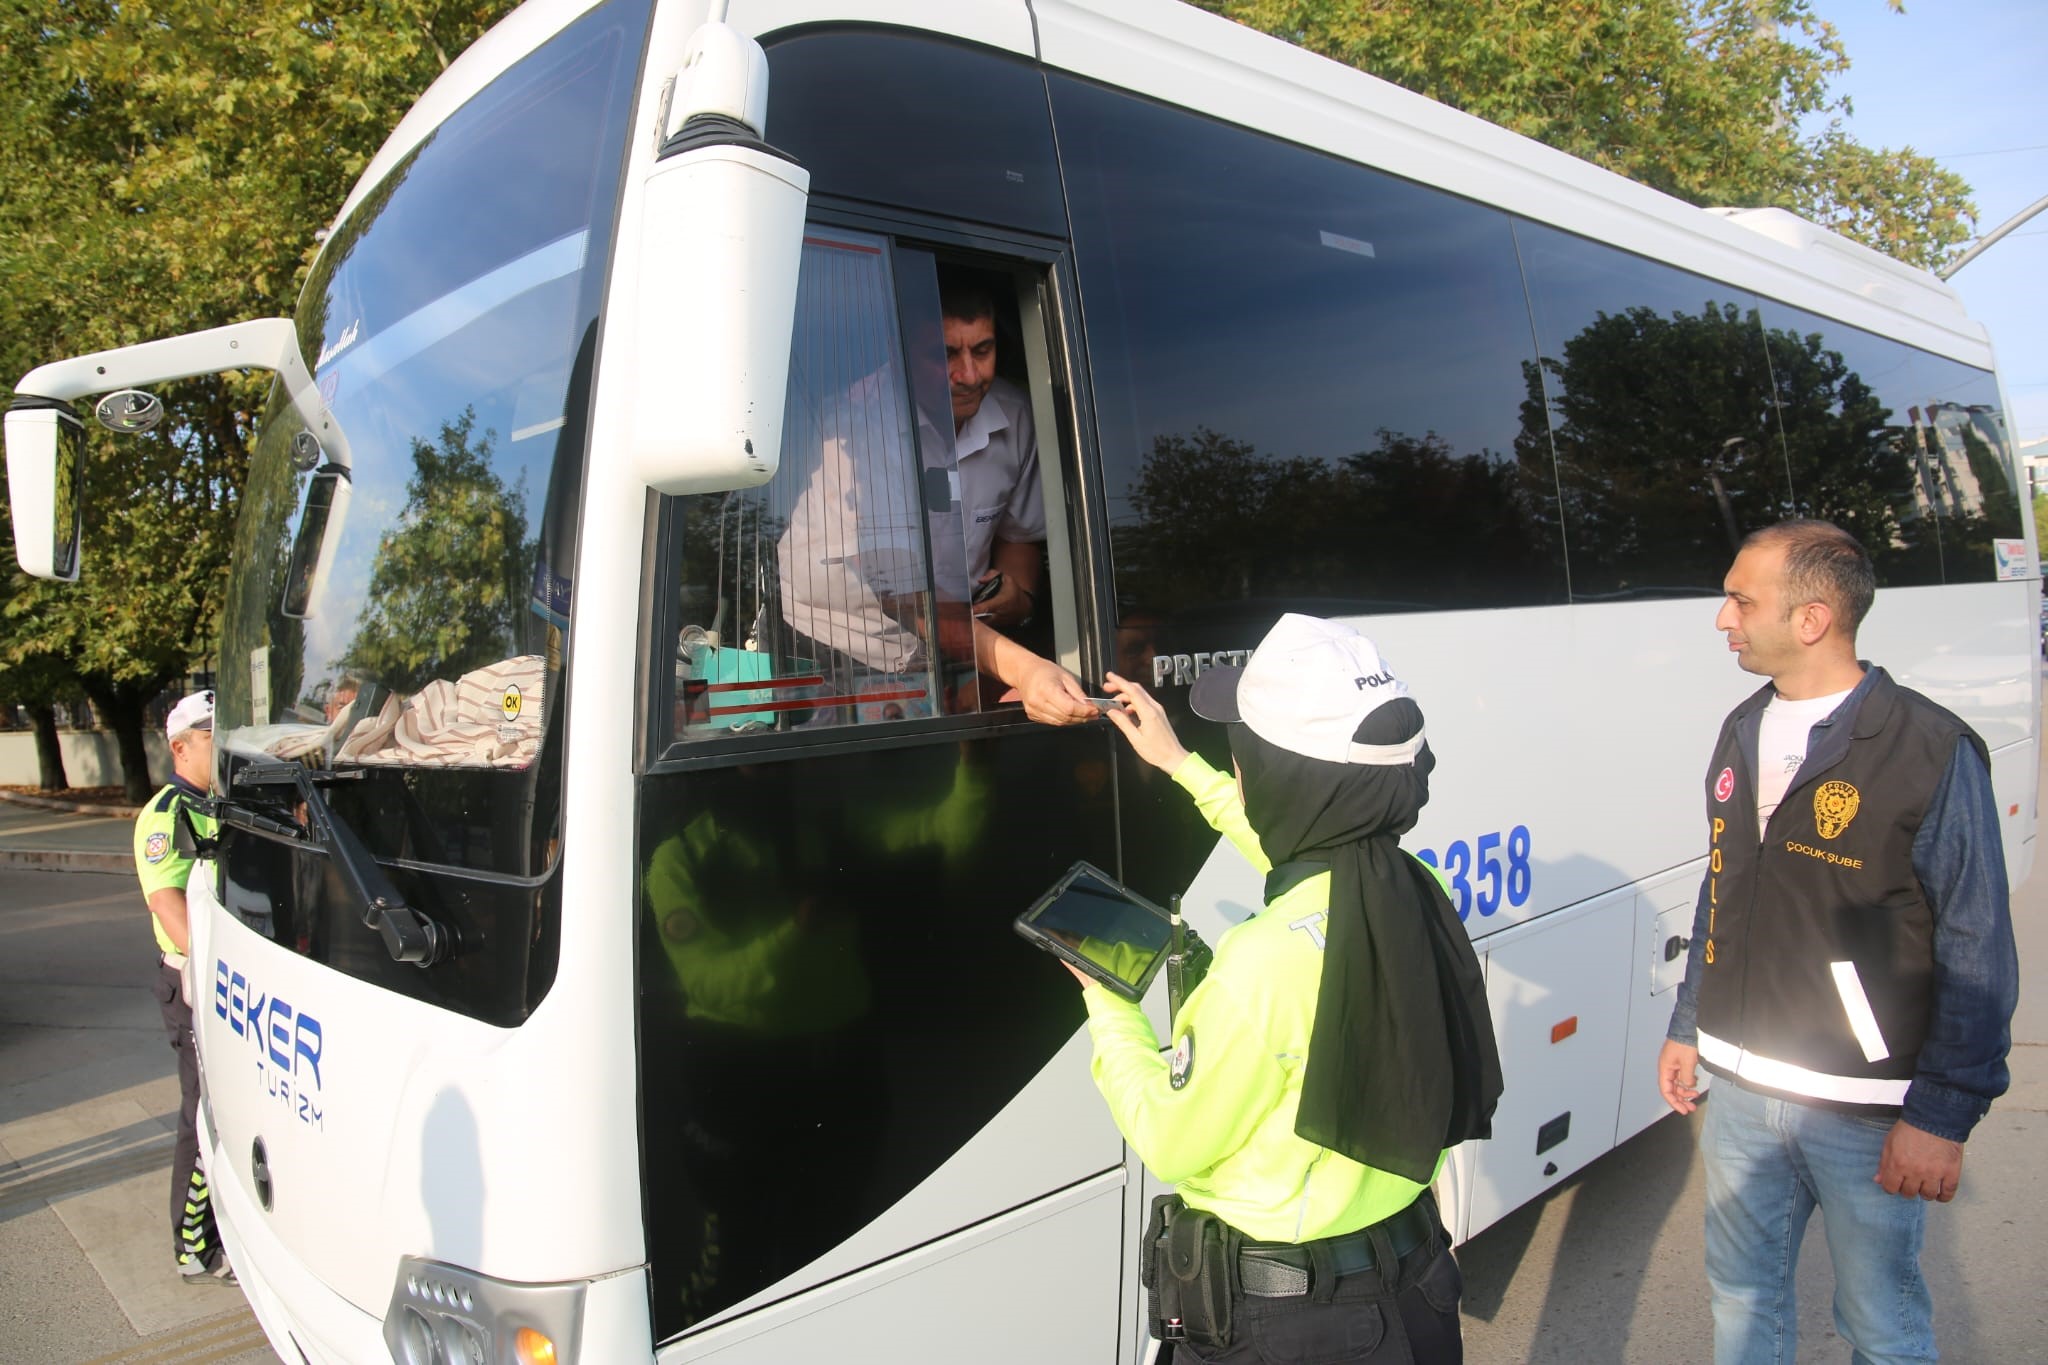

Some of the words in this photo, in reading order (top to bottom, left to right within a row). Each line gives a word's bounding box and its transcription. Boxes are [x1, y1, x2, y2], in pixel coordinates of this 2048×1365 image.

[505, 695, 518, 709] OK
[1416, 825, 1531, 923] 358
[1705, 817, 1725, 964] POLİS
[1786, 841, 1826, 860] ÇOCUK
[1826, 853, 1864, 869] ŞUBE
[216, 958, 322, 1092] BEKER
